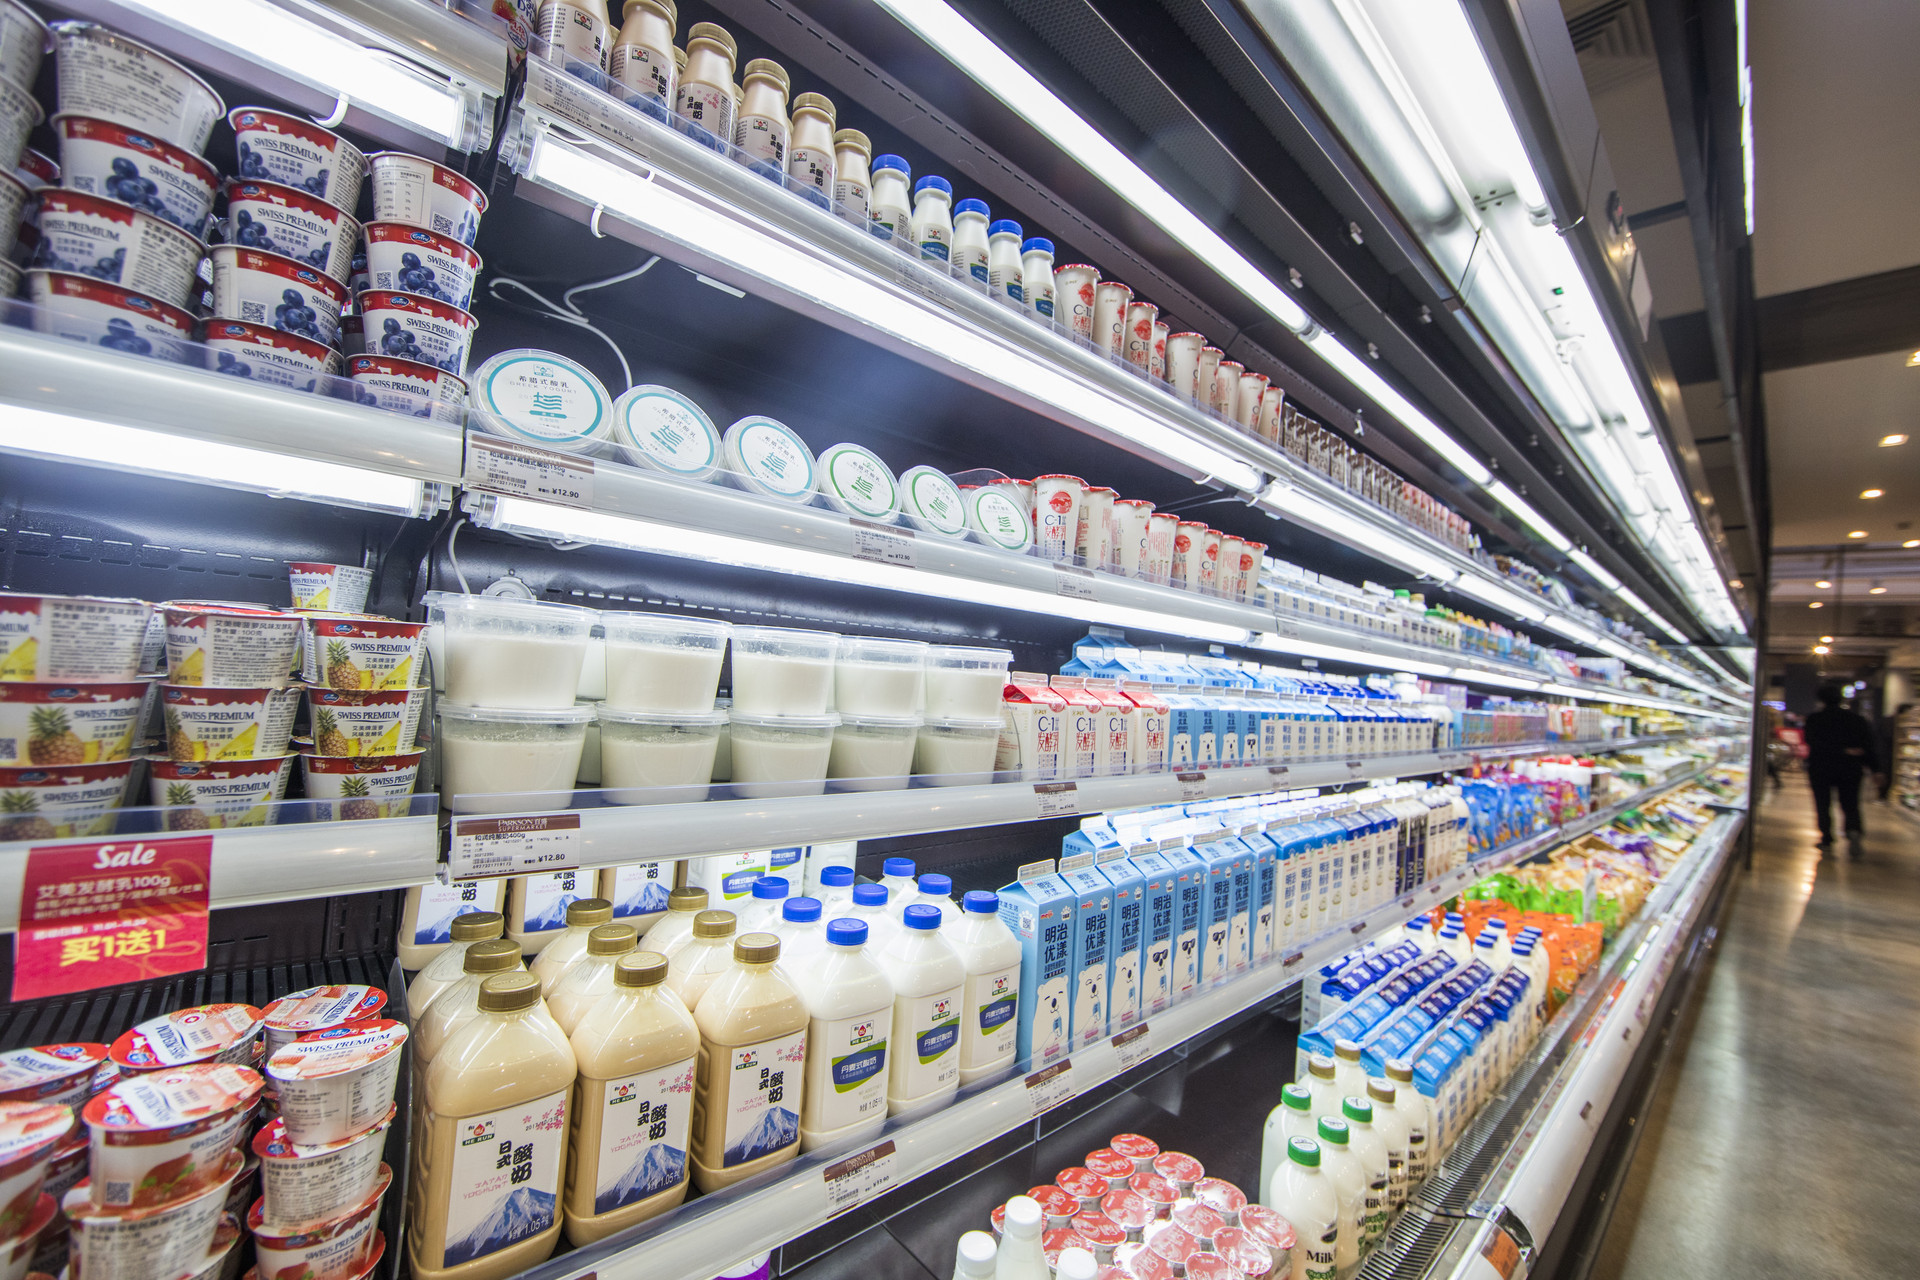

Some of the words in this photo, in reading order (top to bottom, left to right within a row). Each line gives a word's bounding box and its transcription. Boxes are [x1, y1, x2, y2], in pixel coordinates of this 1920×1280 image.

[254, 138, 278, 149] SWISS
[280, 141, 323, 164] PREMIUM
[69, 221, 120, 242] PREMIUM
[258, 208, 284, 221] SWISS
[286, 214, 328, 236] PREMIUM
[427, 254, 450, 269] SWISS
[406, 318, 431, 330] SWISS
[432, 323, 462, 340] PREMIUM
[391, 381, 430, 396] PREMIUM
[551, 487, 579, 498] ¥12.90
[350, 643, 376, 652] SWISS
[376, 643, 411, 653] PREMIUM
[181, 712, 206, 720] SWISS
[208, 712, 255, 720] PREMIUM
[337, 711, 362, 720] SWISS
[363, 711, 400, 719] PREMIUM
[1037, 732, 1059, 752] 发酵乳
[1076, 732, 1096, 752] 发酵乳
[1109, 732, 1128, 751] 发酵乳
[1146, 732, 1165, 750] 发酵乳
[197, 784, 228, 795] SWISS
[228, 781, 271, 793] PREMIUM
[370, 777, 394, 786] SWISS
[498, 819, 534, 827] PARKSON
[498, 824, 548, 832] SUPERMARKET
[93, 843, 157, 870] Sale
[538, 853, 565, 863] ¥12.80
[37, 875, 171, 900] 艾美发酵乳100g
[1182, 886, 1199, 902] 明治
[1121, 902, 1140, 920] 明治
[1153, 894, 1172, 911] 明治
[1085, 912, 1107, 933] 明治
[1121, 918, 1140, 939] 优漾
[1044, 922, 1068, 944] 明治
[1085, 930, 1107, 952] 优漾
[59, 928, 167, 968] 买1送1
[1044, 940, 1068, 964] 优漾
[297, 1044, 333, 1054] SWISS
[334, 1033, 391, 1049] PREMIUM
[840, 1056, 877, 1074] 丹麦式酸奶
[768, 1071, 784, 1103] 酸奶
[649, 1103, 668, 1141] 酸奶
[465, 1137, 475, 1145] HE
[477, 1134, 494, 1142] RUN
[511, 1143, 534, 1185] 酸奶
[1306, 1249, 1334, 1264] Milk
